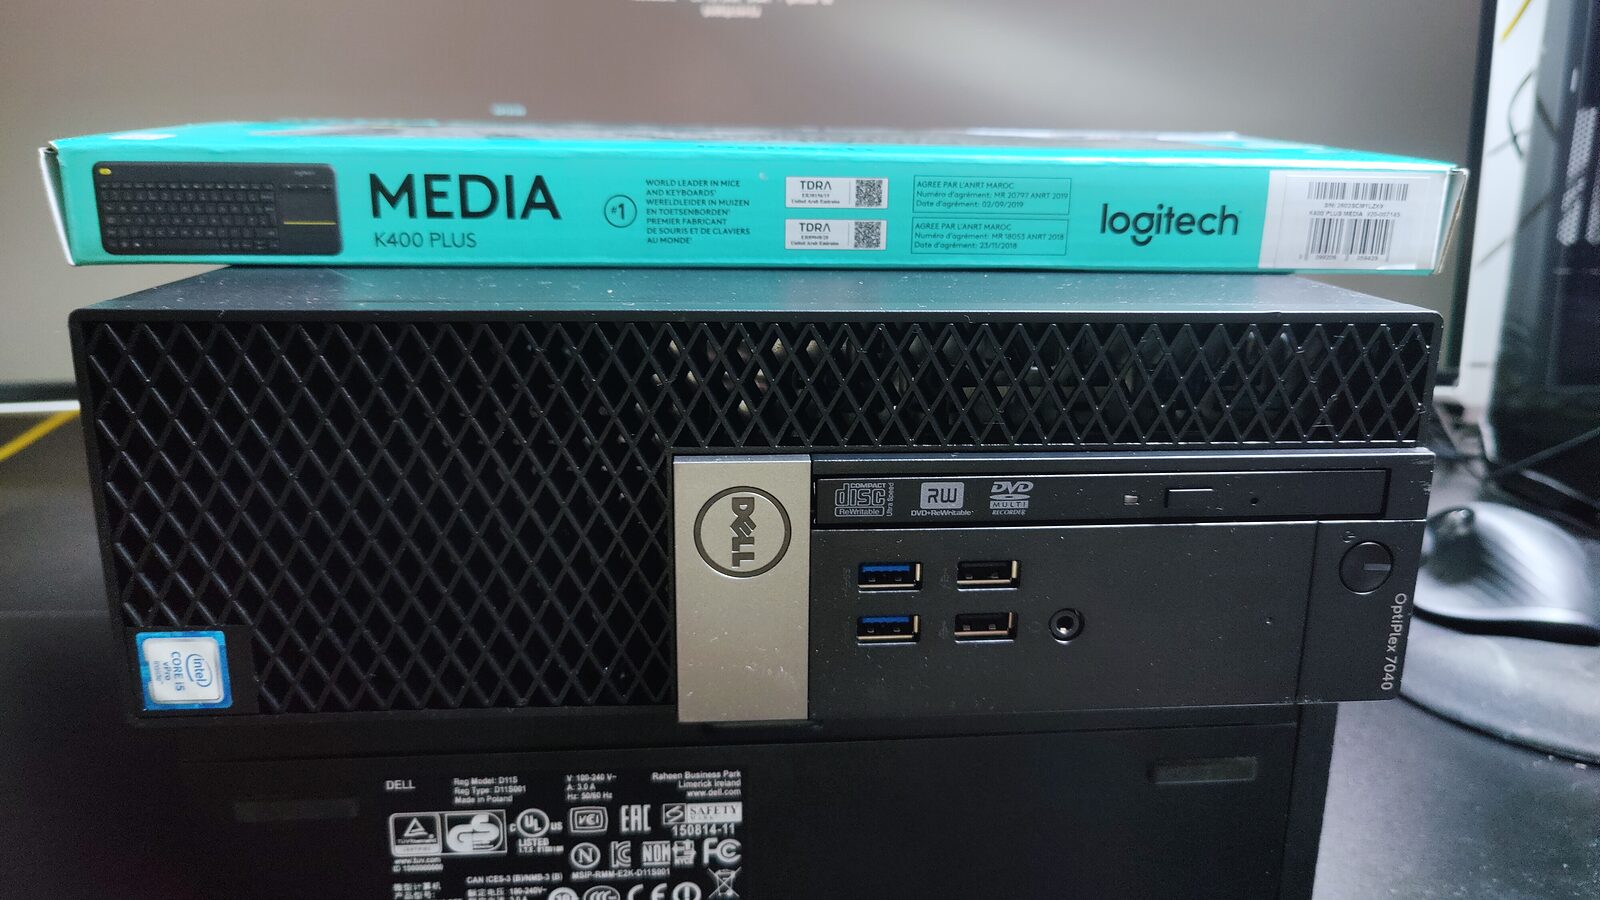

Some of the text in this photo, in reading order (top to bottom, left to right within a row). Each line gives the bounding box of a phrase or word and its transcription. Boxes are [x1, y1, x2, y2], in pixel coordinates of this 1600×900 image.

[800, 180, 832, 190] TDRA
[917, 181, 941, 189] AGREE
[959, 182, 985, 190] L'ANRT
[986, 182, 1014, 190] MAROC
[369, 173, 562, 220] MEDIA
[1007, 192, 1029, 200] 20797
[1030, 192, 1050, 200] ANRT
[719, 199, 750, 207] MUIZEN
[916, 200, 934, 208] Date
[981, 201, 1024, 209] 02/09/2019
[610, 203, 626, 220] #1
[799, 222, 831, 232] TDRA
[957, 223, 982, 231] L'ANRT
[1100, 203, 1240, 246] logitech
[375, 232, 477, 249] K400 PLUS
[915, 232, 944, 240] Numéro
[1026, 233, 1046, 241] ANRT
[1048, 233, 1064, 241] 2018
[991, 481, 1034, 493] DVD
[927, 487, 957, 504] RW
[839, 508, 880, 516] ReWritable
[730, 497, 756, 567] DELL
[1381, 593, 1407, 691] OptiPlex 7040
[171, 651, 183, 679] CORE
[193, 658, 207, 682] intel
[652, 770, 742, 780] Raheen Business Park
[386, 780, 416, 790] DELL
[454, 778, 469, 786] Reg
[471, 777, 496, 785] Model:
[679, 779, 742, 788] Limerick Ireland
[454, 787, 470, 795] Reg
[687, 788, 742, 797] www.dell.com
[487, 795, 513, 803] Poland
[690, 805, 736, 815] SAFETY
[551, 822, 563, 831] US
[672, 823, 735, 836] 150814-11
[518, 838, 550, 847] LISTED
[466, 876, 484, 884] CAN
[486, 874, 511, 883] ICES-3
[552, 872, 563, 881] (B)
